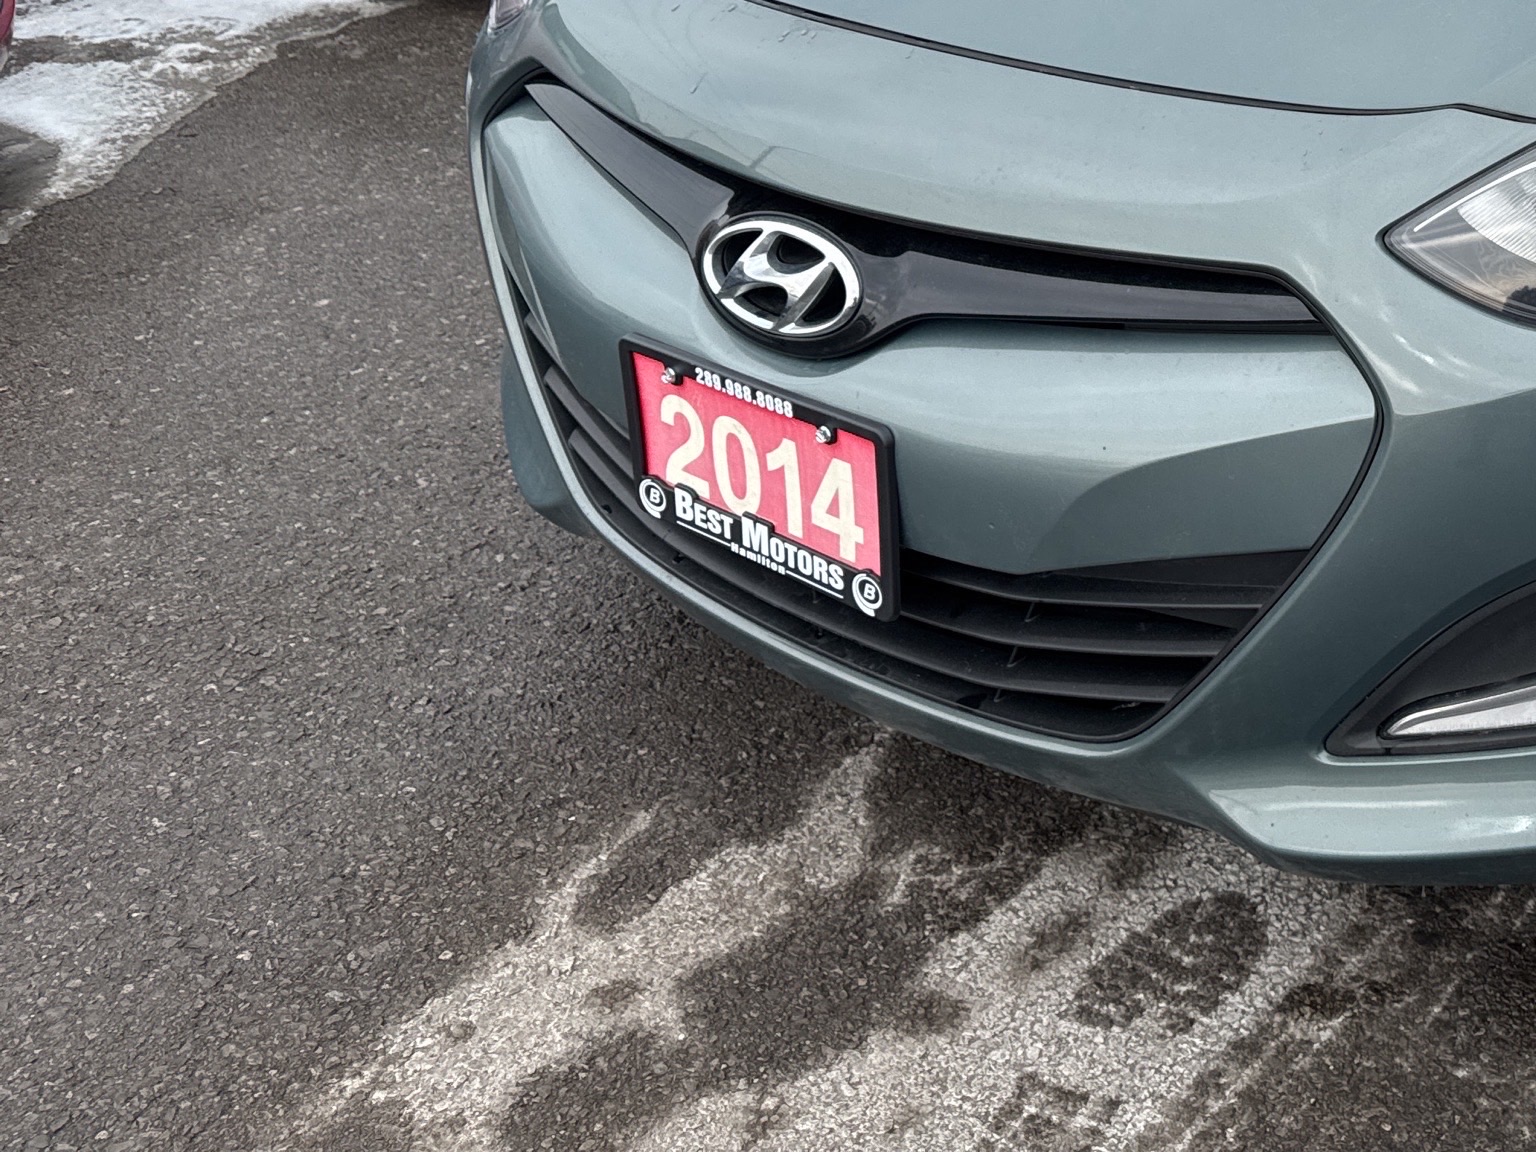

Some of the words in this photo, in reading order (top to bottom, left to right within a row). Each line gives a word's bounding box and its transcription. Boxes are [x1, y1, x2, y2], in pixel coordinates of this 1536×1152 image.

[695, 367, 793, 418] 289.988.8088
[660, 394, 864, 563] 2014
[674, 486, 733, 539] BEST
[741, 515, 844, 591] MOTORS
[731, 542, 786, 576] Hamilton
